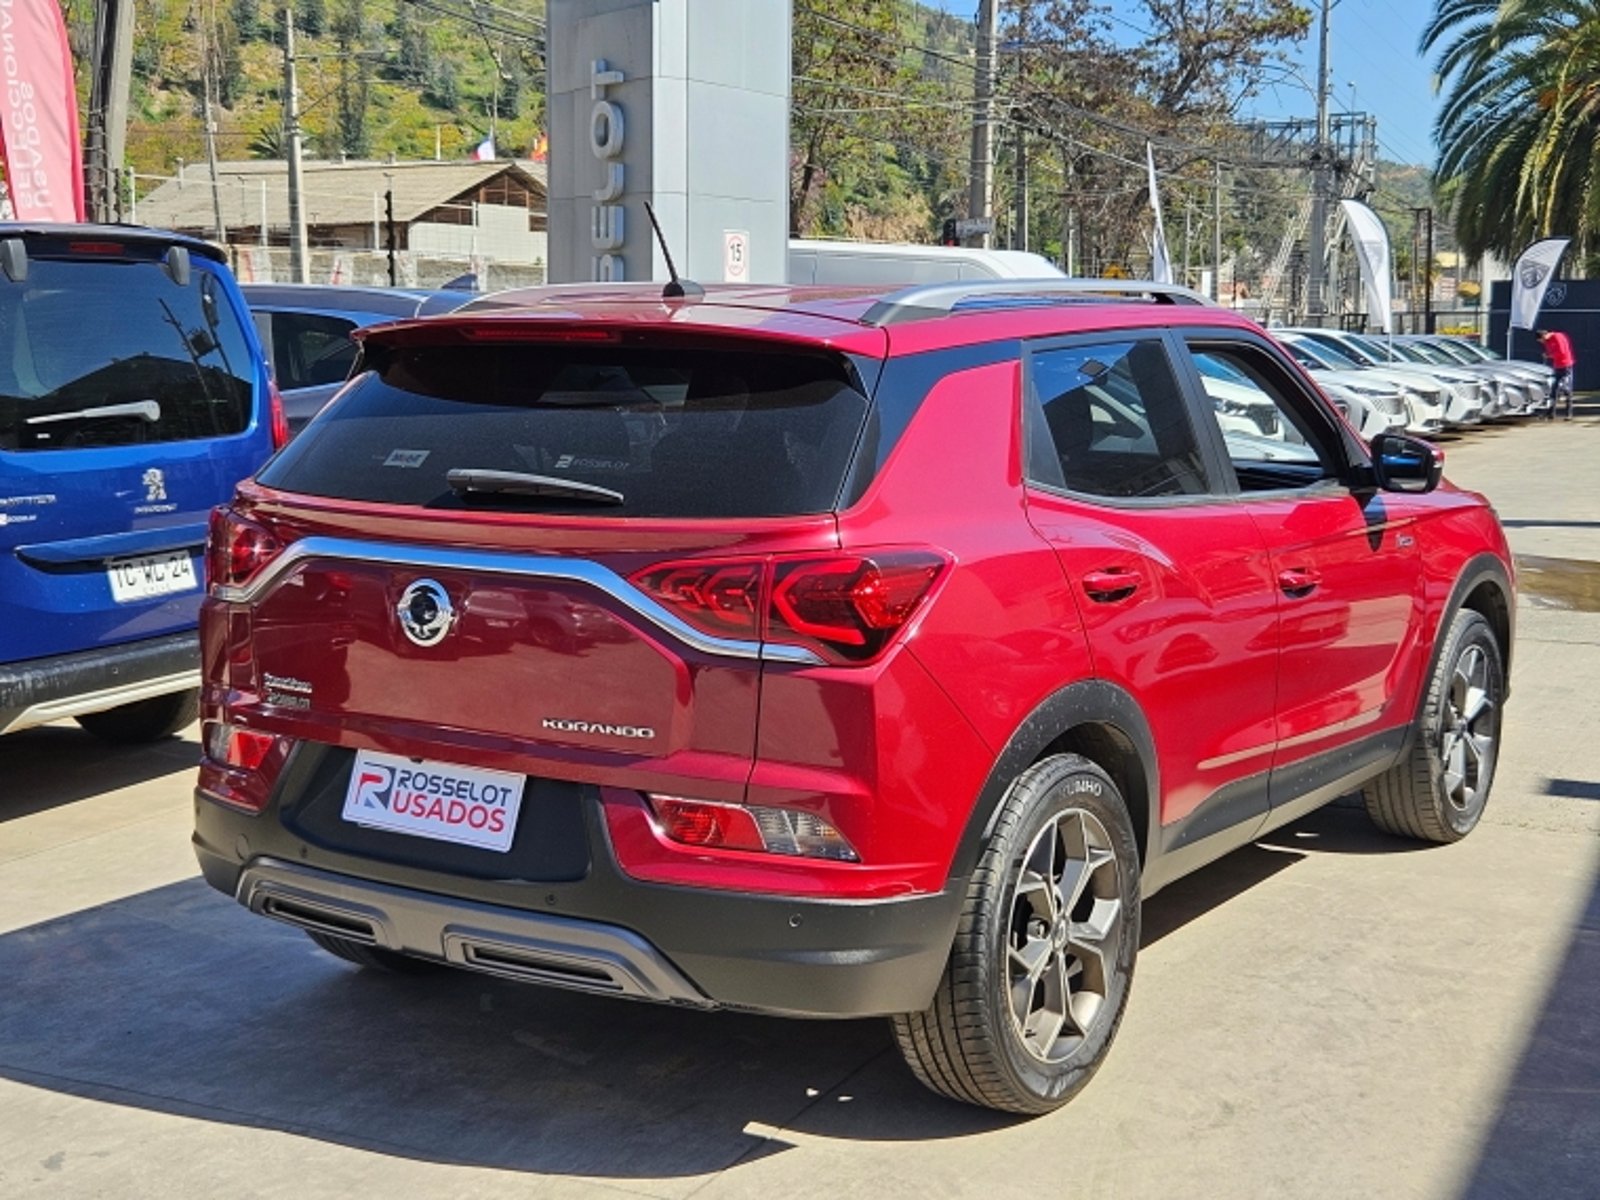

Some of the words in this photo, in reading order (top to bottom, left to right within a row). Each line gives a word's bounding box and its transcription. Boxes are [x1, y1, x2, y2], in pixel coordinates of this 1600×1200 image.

[730, 243, 742, 262] 15
[542, 719, 655, 739] KORANDO
[397, 769, 512, 807] ROSSELOT
[393, 790, 506, 833] USADOS
